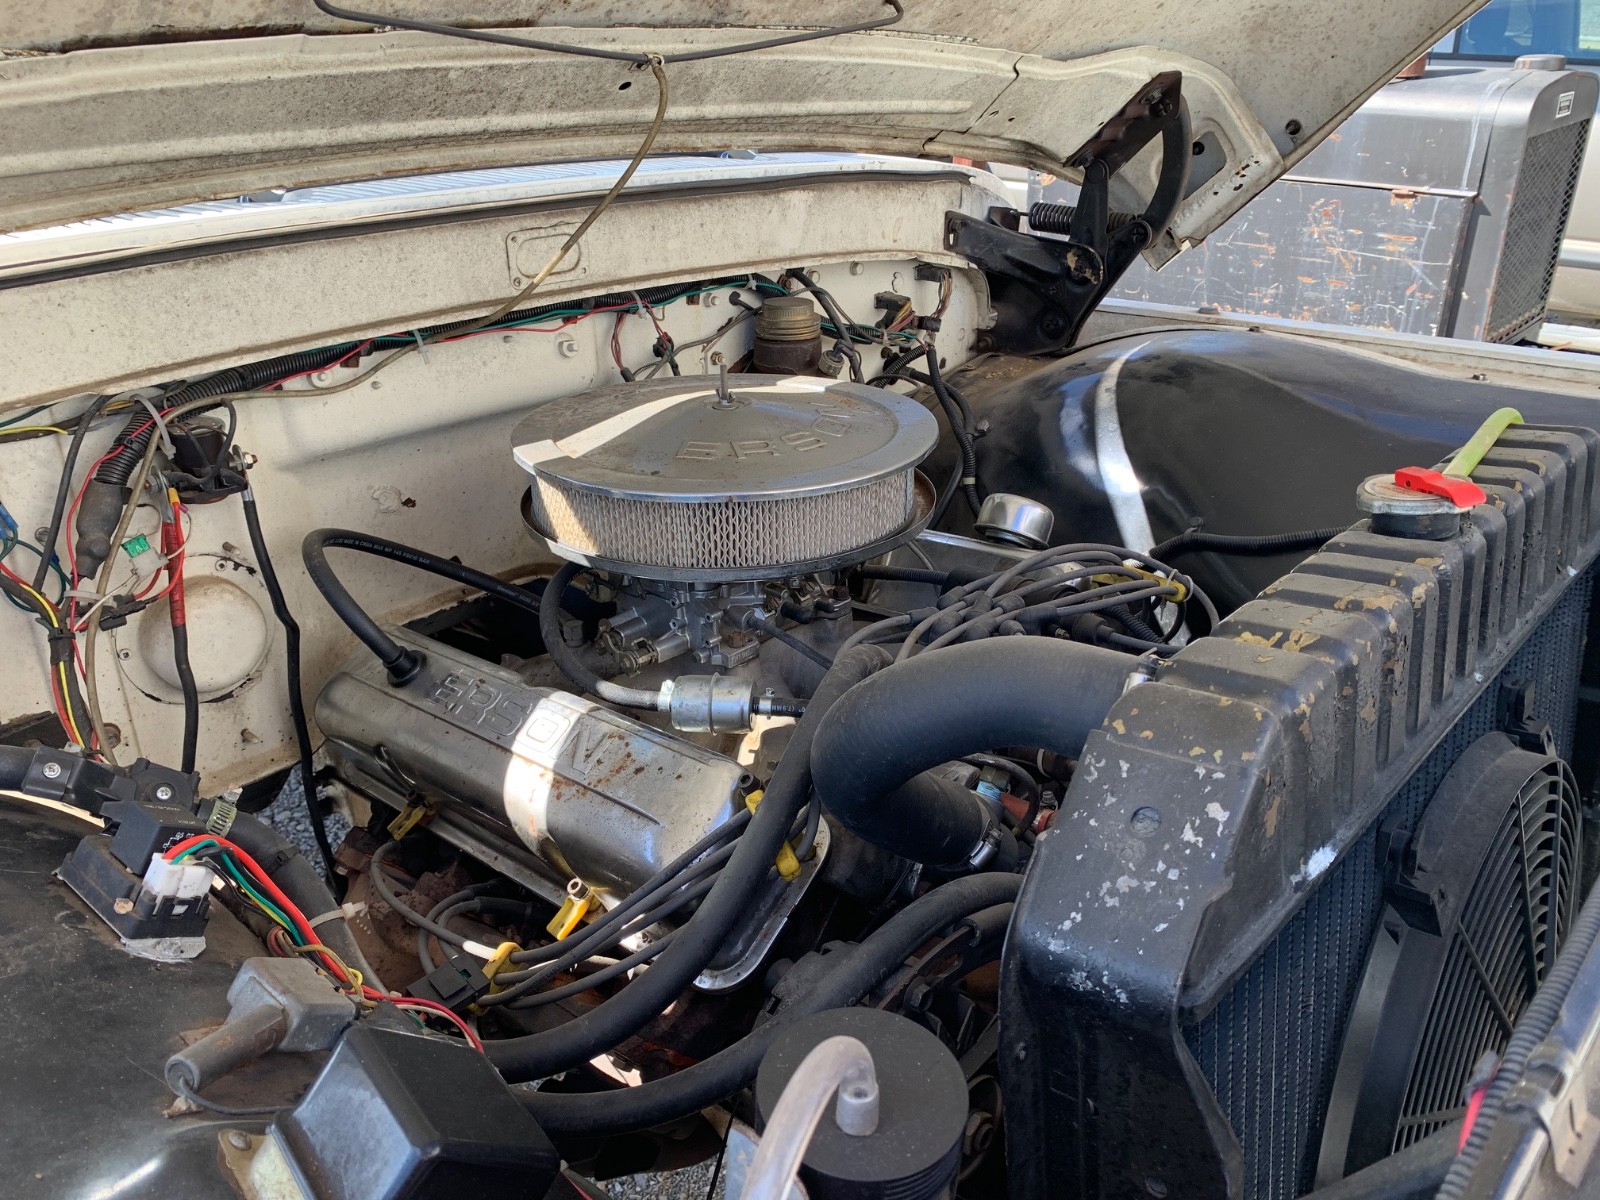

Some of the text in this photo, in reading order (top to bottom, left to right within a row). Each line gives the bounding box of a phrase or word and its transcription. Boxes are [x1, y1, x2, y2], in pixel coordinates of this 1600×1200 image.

[675, 402, 857, 460] ERSON
[360, 540, 373, 549] CHINA
[424, 668, 620, 776] ERSON
